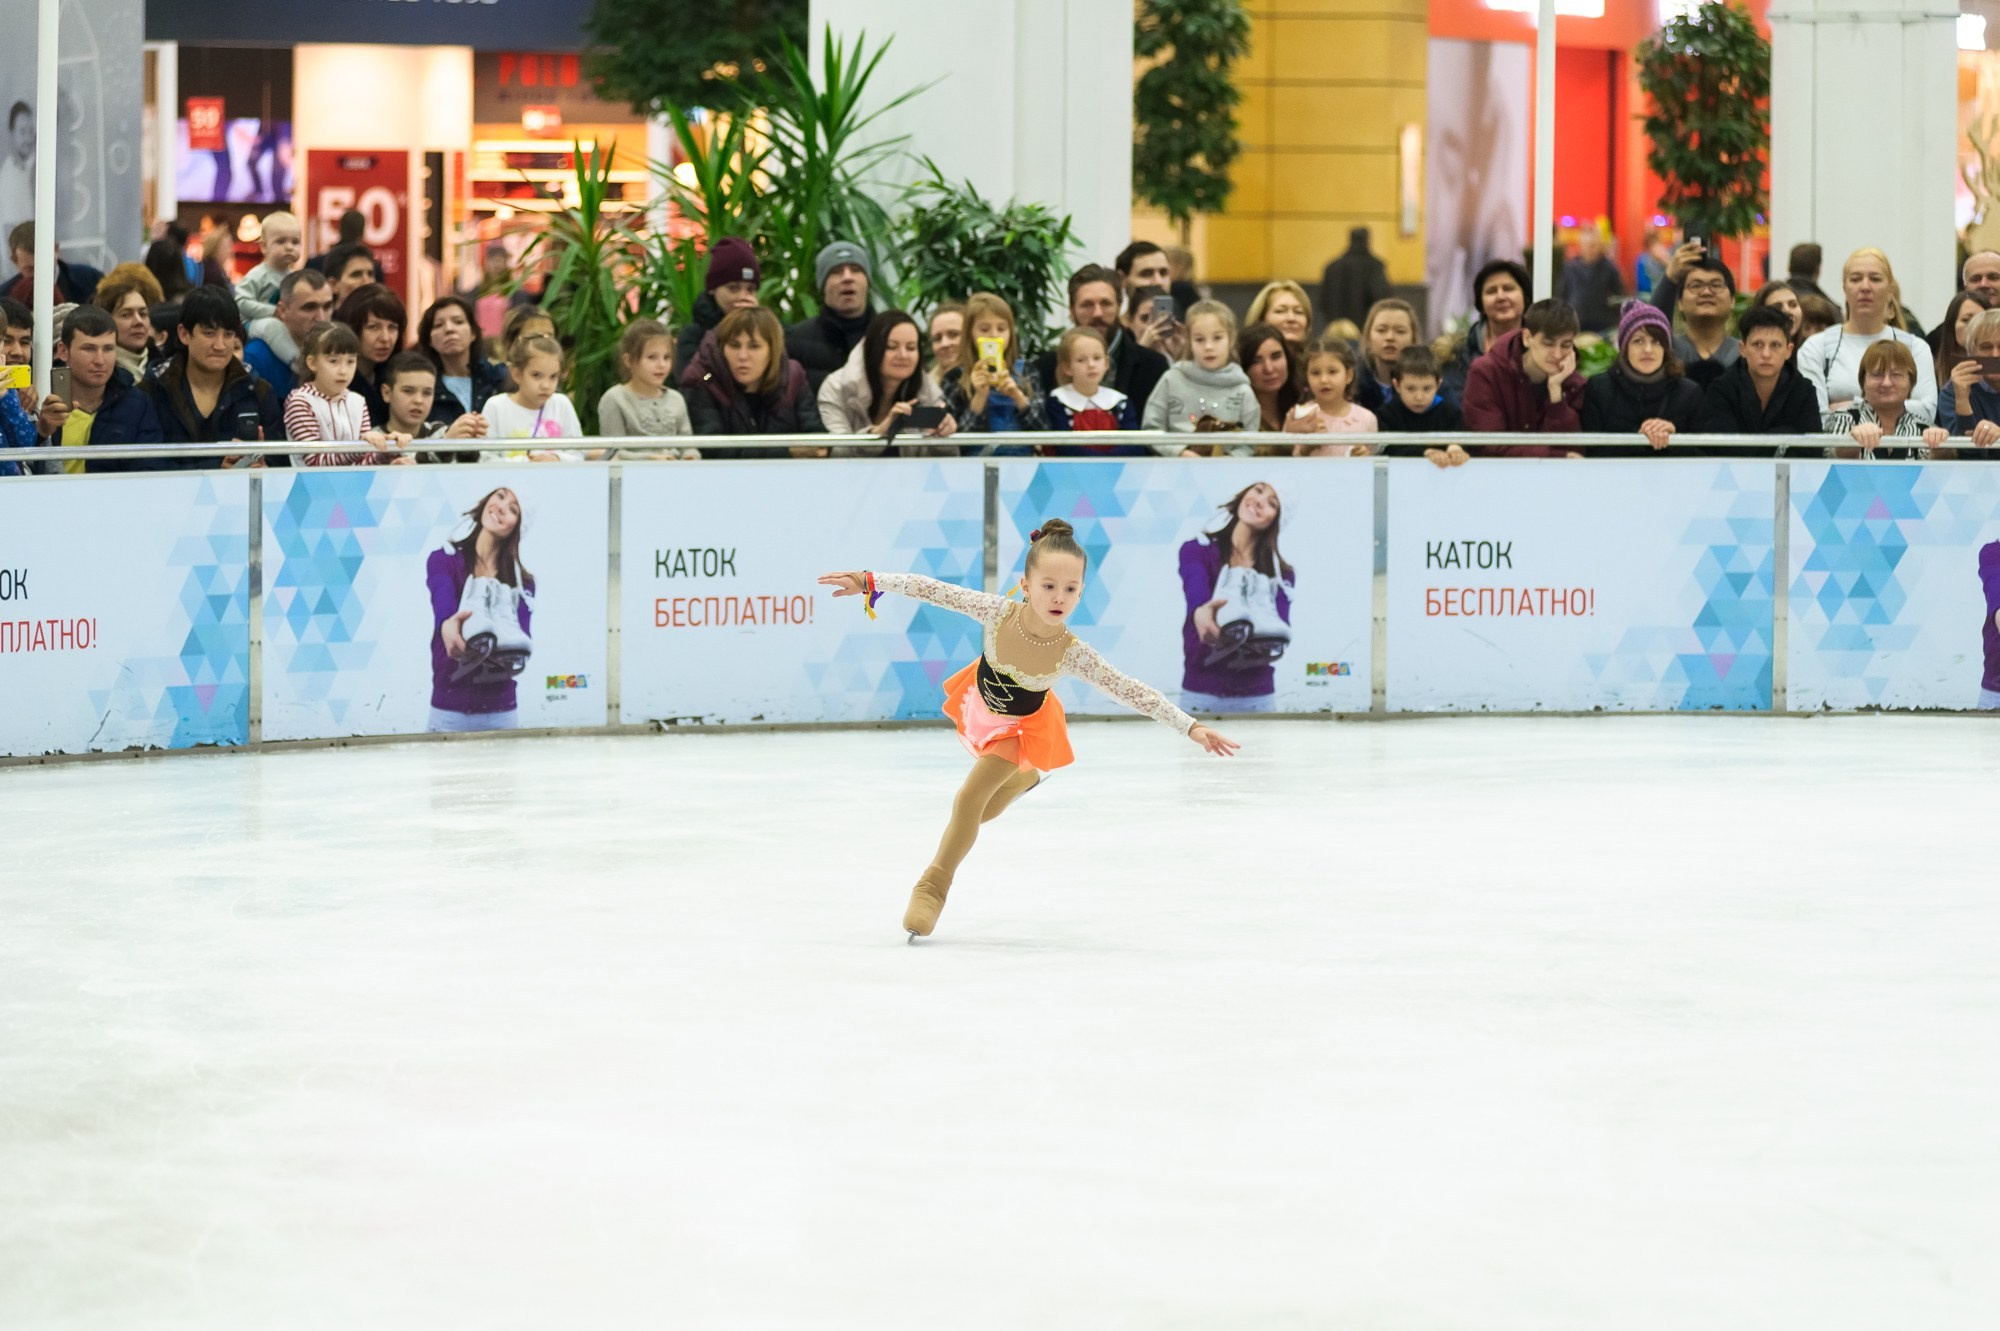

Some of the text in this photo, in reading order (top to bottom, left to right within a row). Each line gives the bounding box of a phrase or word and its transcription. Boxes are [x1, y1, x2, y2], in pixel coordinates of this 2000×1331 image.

[655, 548, 736, 578] КАТОК
[1426, 541, 1512, 569] КАТОК
[655, 595, 814, 628] БЕСПЛАТНО!
[1426, 588, 1594, 616] БЕСПЛАТНО!
